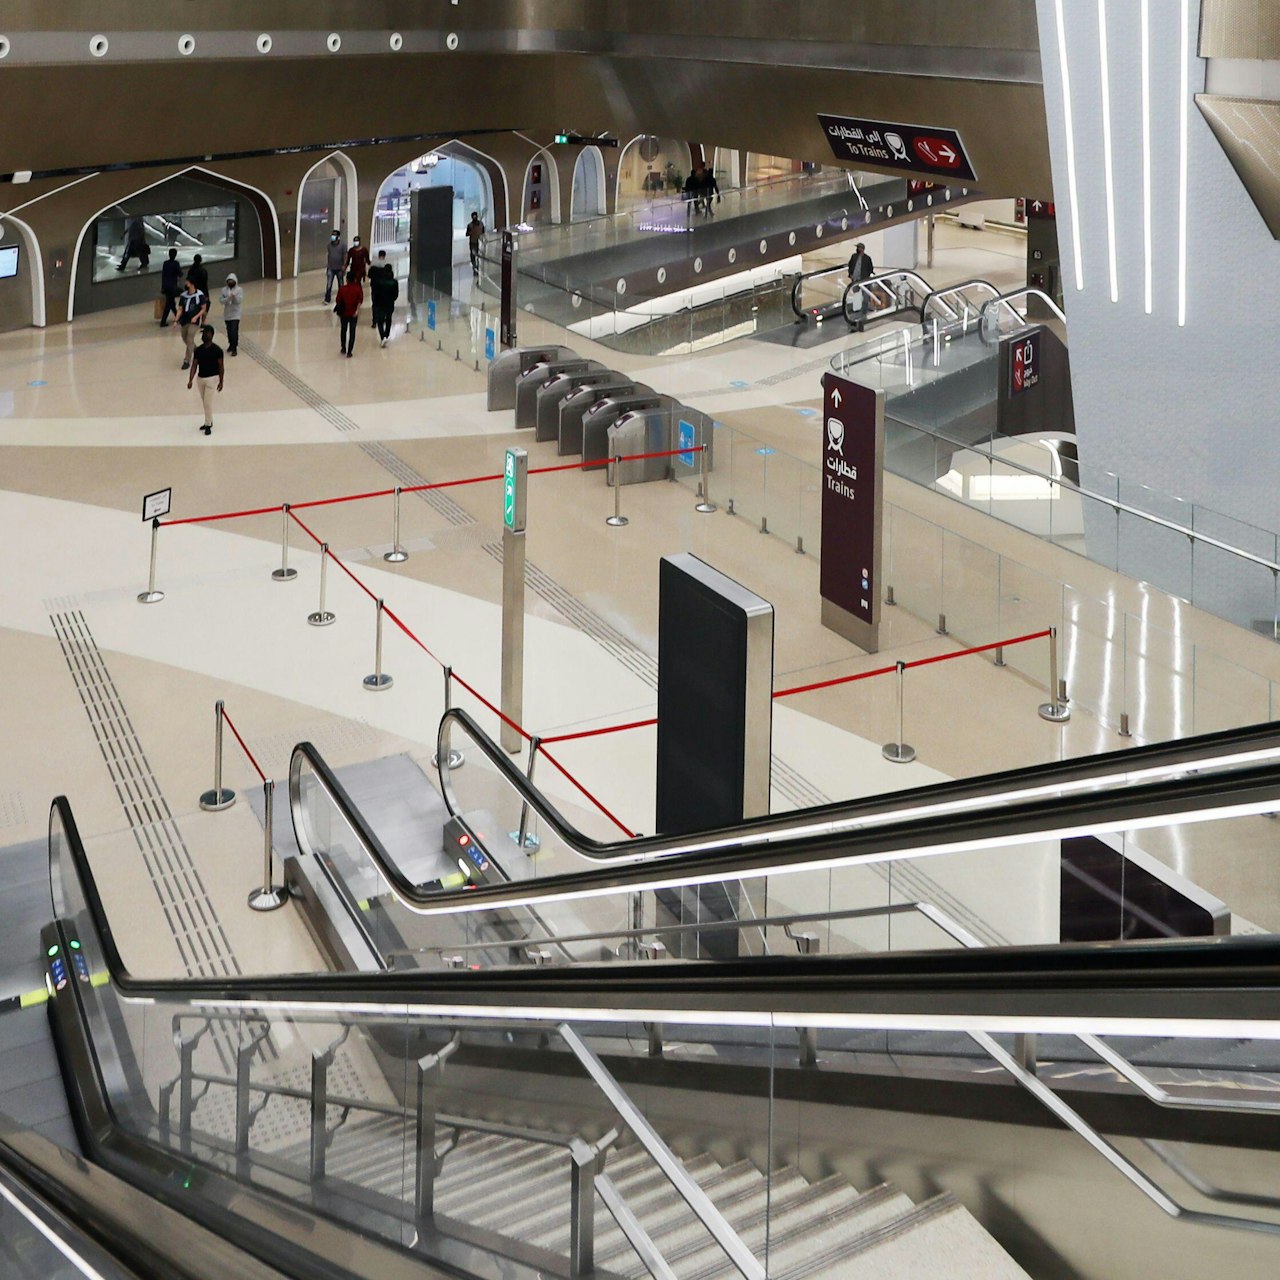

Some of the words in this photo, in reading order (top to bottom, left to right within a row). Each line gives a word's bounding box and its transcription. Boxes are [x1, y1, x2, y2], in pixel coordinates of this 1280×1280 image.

[827, 124, 865, 140] القطارات
[865, 130, 883, 146] إلى
[846, 142, 859, 155] To
[857, 144, 890, 159] Trains
[826, 457, 857, 480] قطارات
[826, 474, 855, 500] Trains
